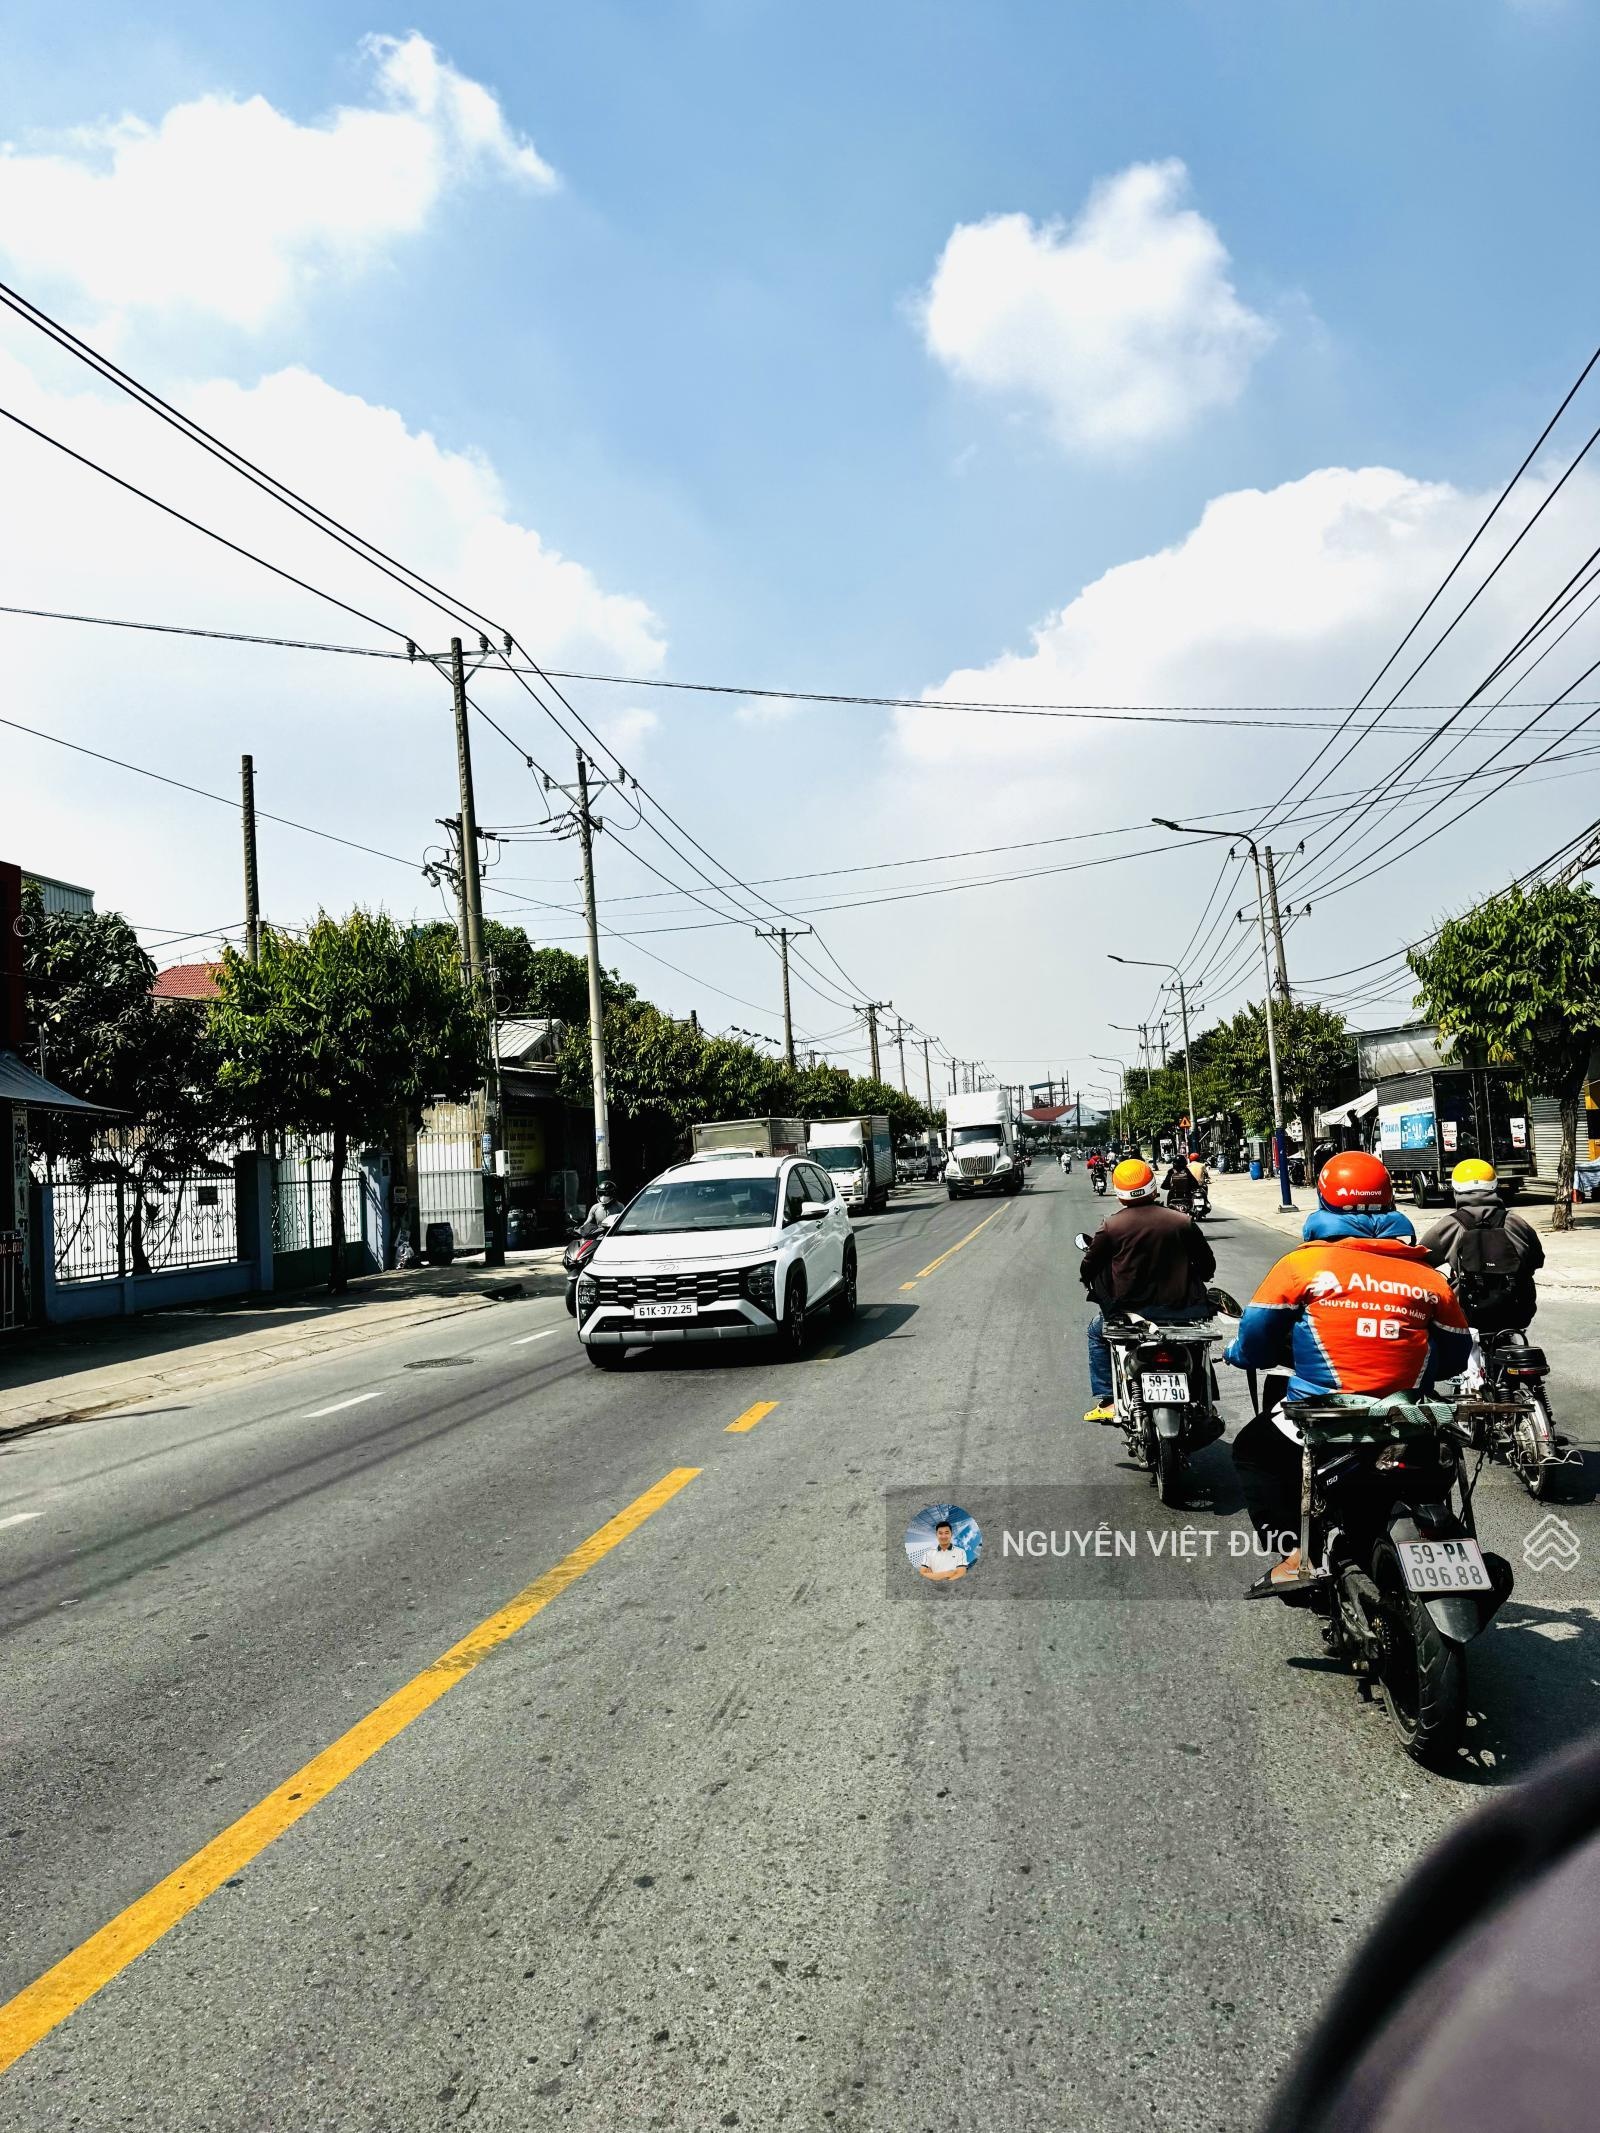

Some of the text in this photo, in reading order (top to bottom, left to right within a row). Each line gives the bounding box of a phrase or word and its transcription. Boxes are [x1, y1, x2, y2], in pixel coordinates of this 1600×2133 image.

[1349, 1188, 1382, 1197] Ahamove
[1348, 1273, 1439, 1305] Ahamove
[640, 1304, 692, 1316] 61K-372.25
[1319, 1299, 1358, 1309] CHUYÊN
[1362, 1303, 1381, 1311] GIA
[1384, 1304, 1407, 1315] GIAO
[1410, 1543, 1470, 1565] 59-PA
[1412, 1565, 1483, 1588] 096.88
